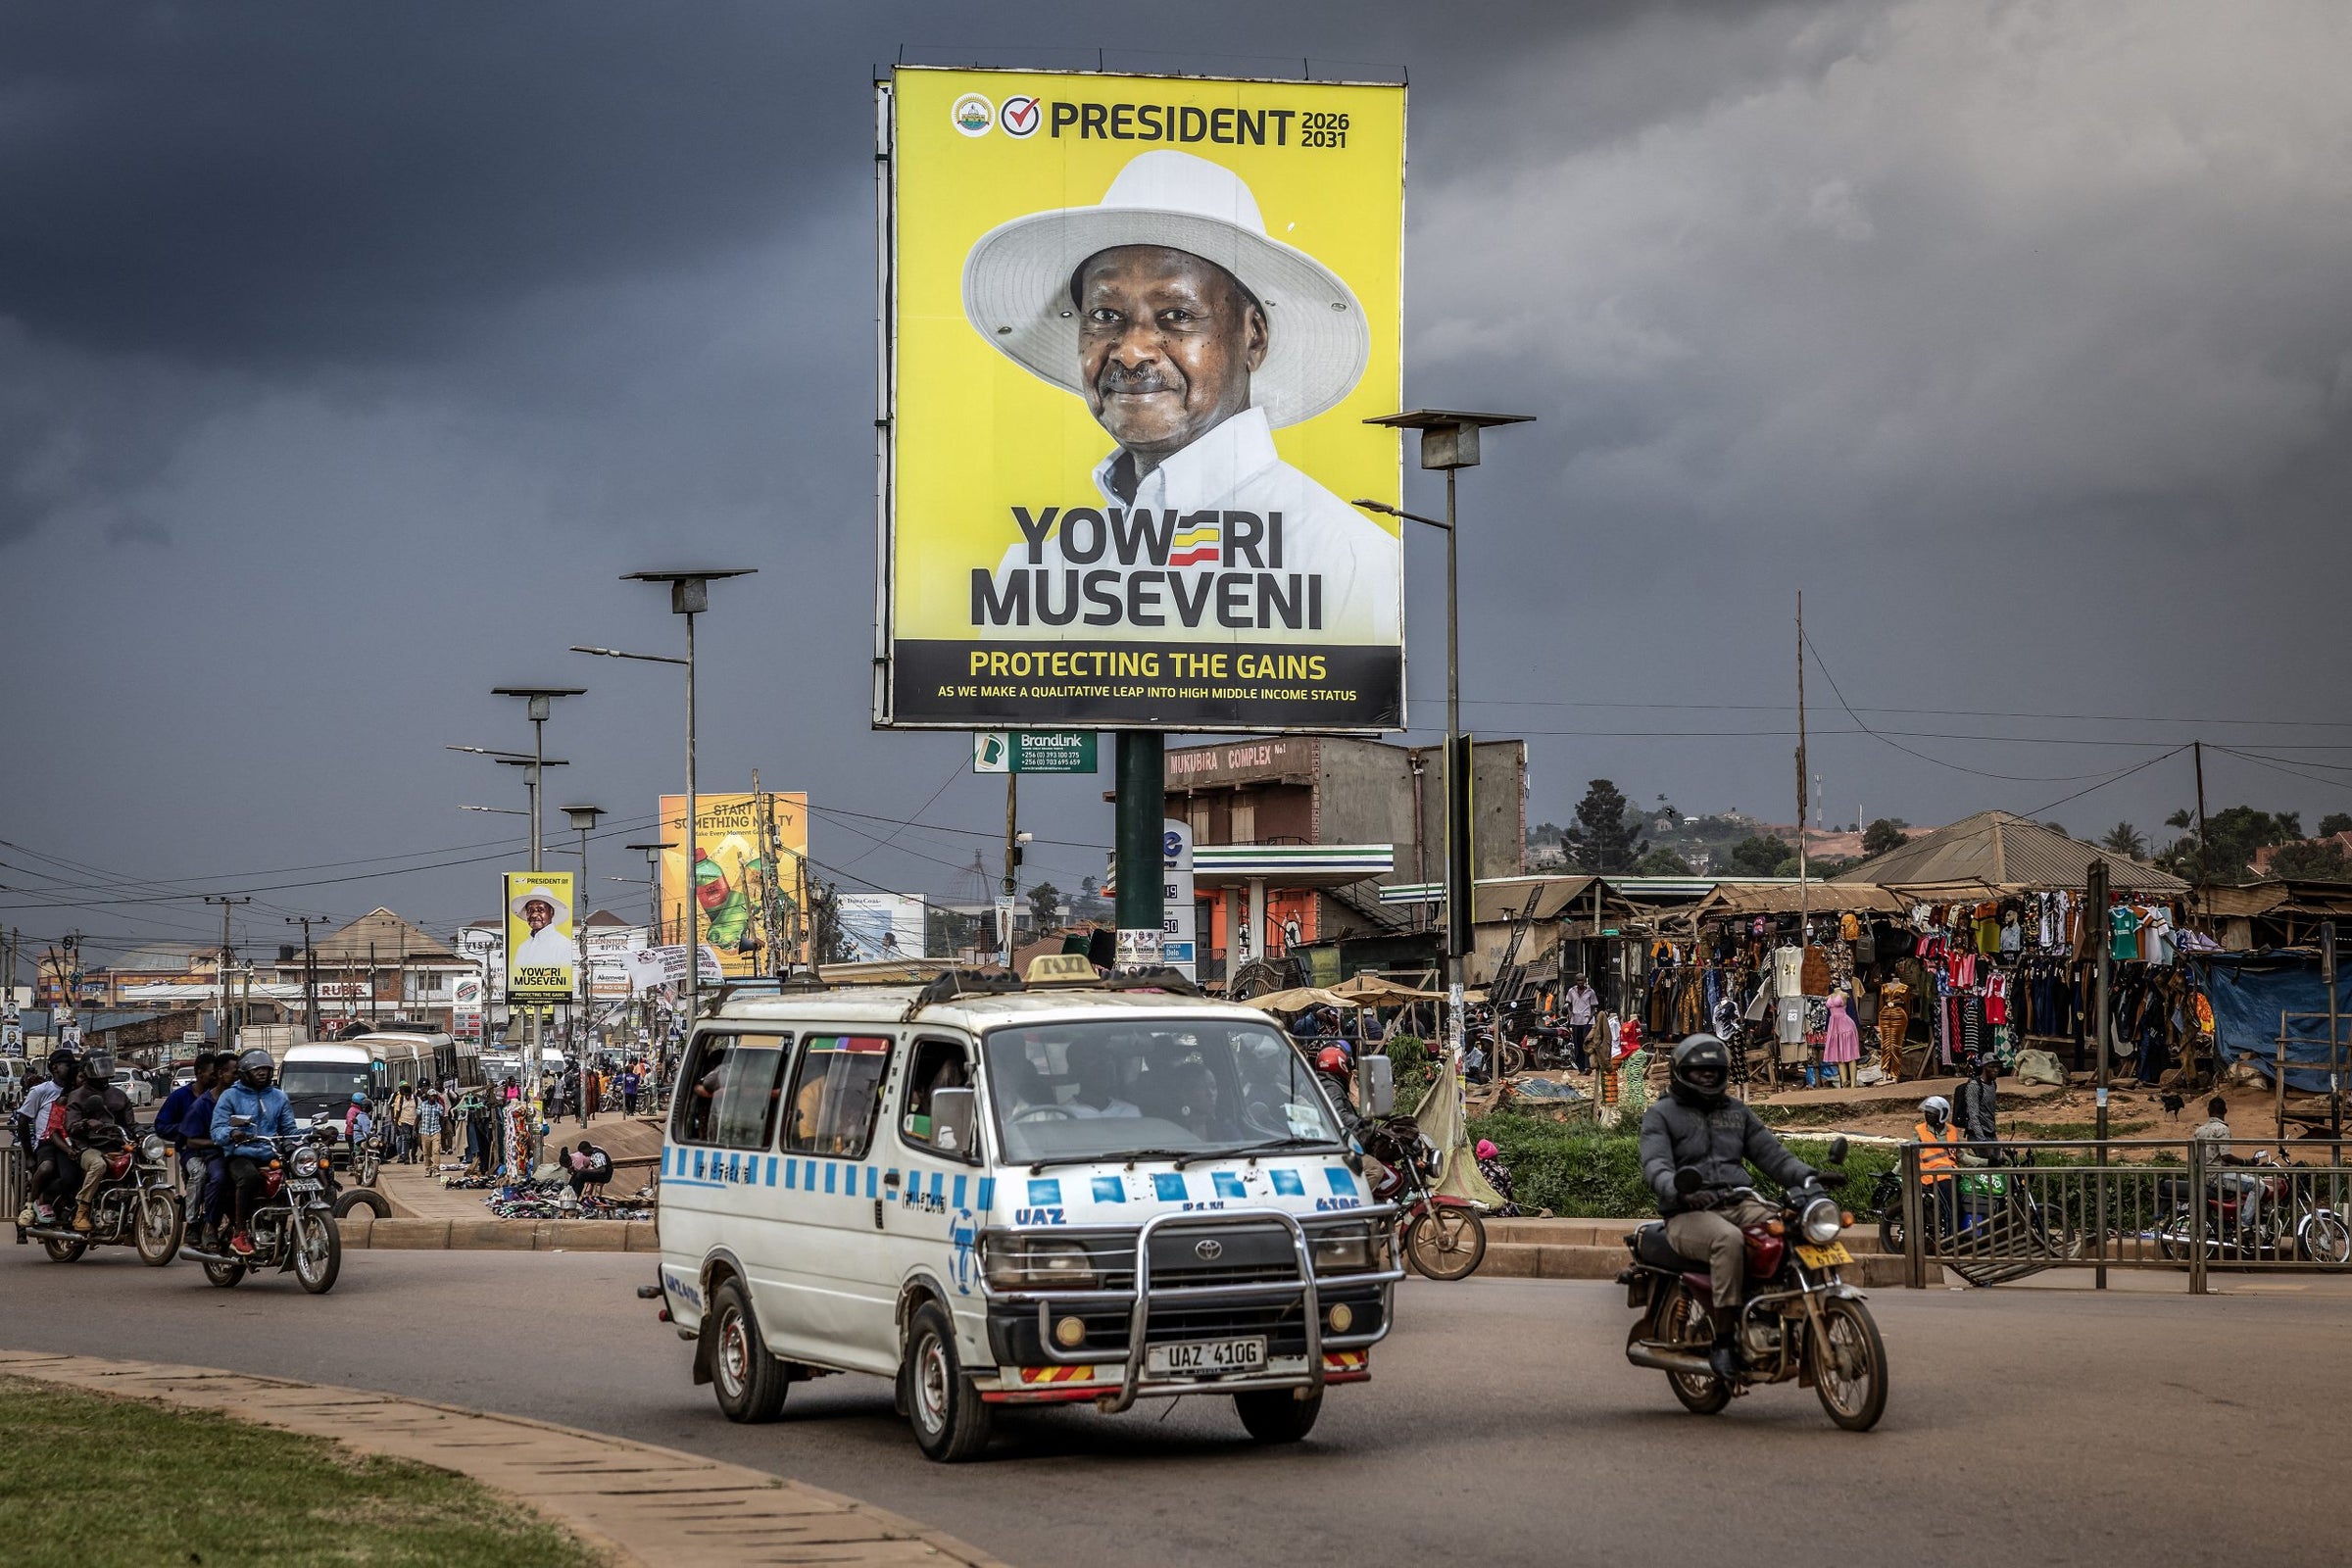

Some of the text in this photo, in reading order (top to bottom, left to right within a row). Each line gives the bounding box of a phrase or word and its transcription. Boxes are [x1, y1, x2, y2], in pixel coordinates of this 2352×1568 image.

[1051, 102, 1296, 146] PRESIDENT
[1300, 112, 1349, 130] 2026
[1300, 130, 1347, 149] 2031
[1010, 507, 1284, 568] YOWERI
[971, 568, 1322, 629] MUSEVENI
[969, 651, 1327, 680] PROTECTING THE GAINS
[938, 686, 1357, 701] AS WE MAKE A QUALITATIVE LEAP INTO HIGH MIDDLE INCOME STATUS
[1228, 745, 1271, 769] COMPLEX
[713, 804, 753, 816] START
[1040, 956, 1085, 974] TAXI
[514, 976, 566, 986] MUSEVENI
[321, 985, 364, 996] RUBS
[1787, 1012, 1798, 1021] 83
[1015, 1207, 1066, 1225] UAZ
[1169, 1343, 1257, 1367] UAZ 410G
